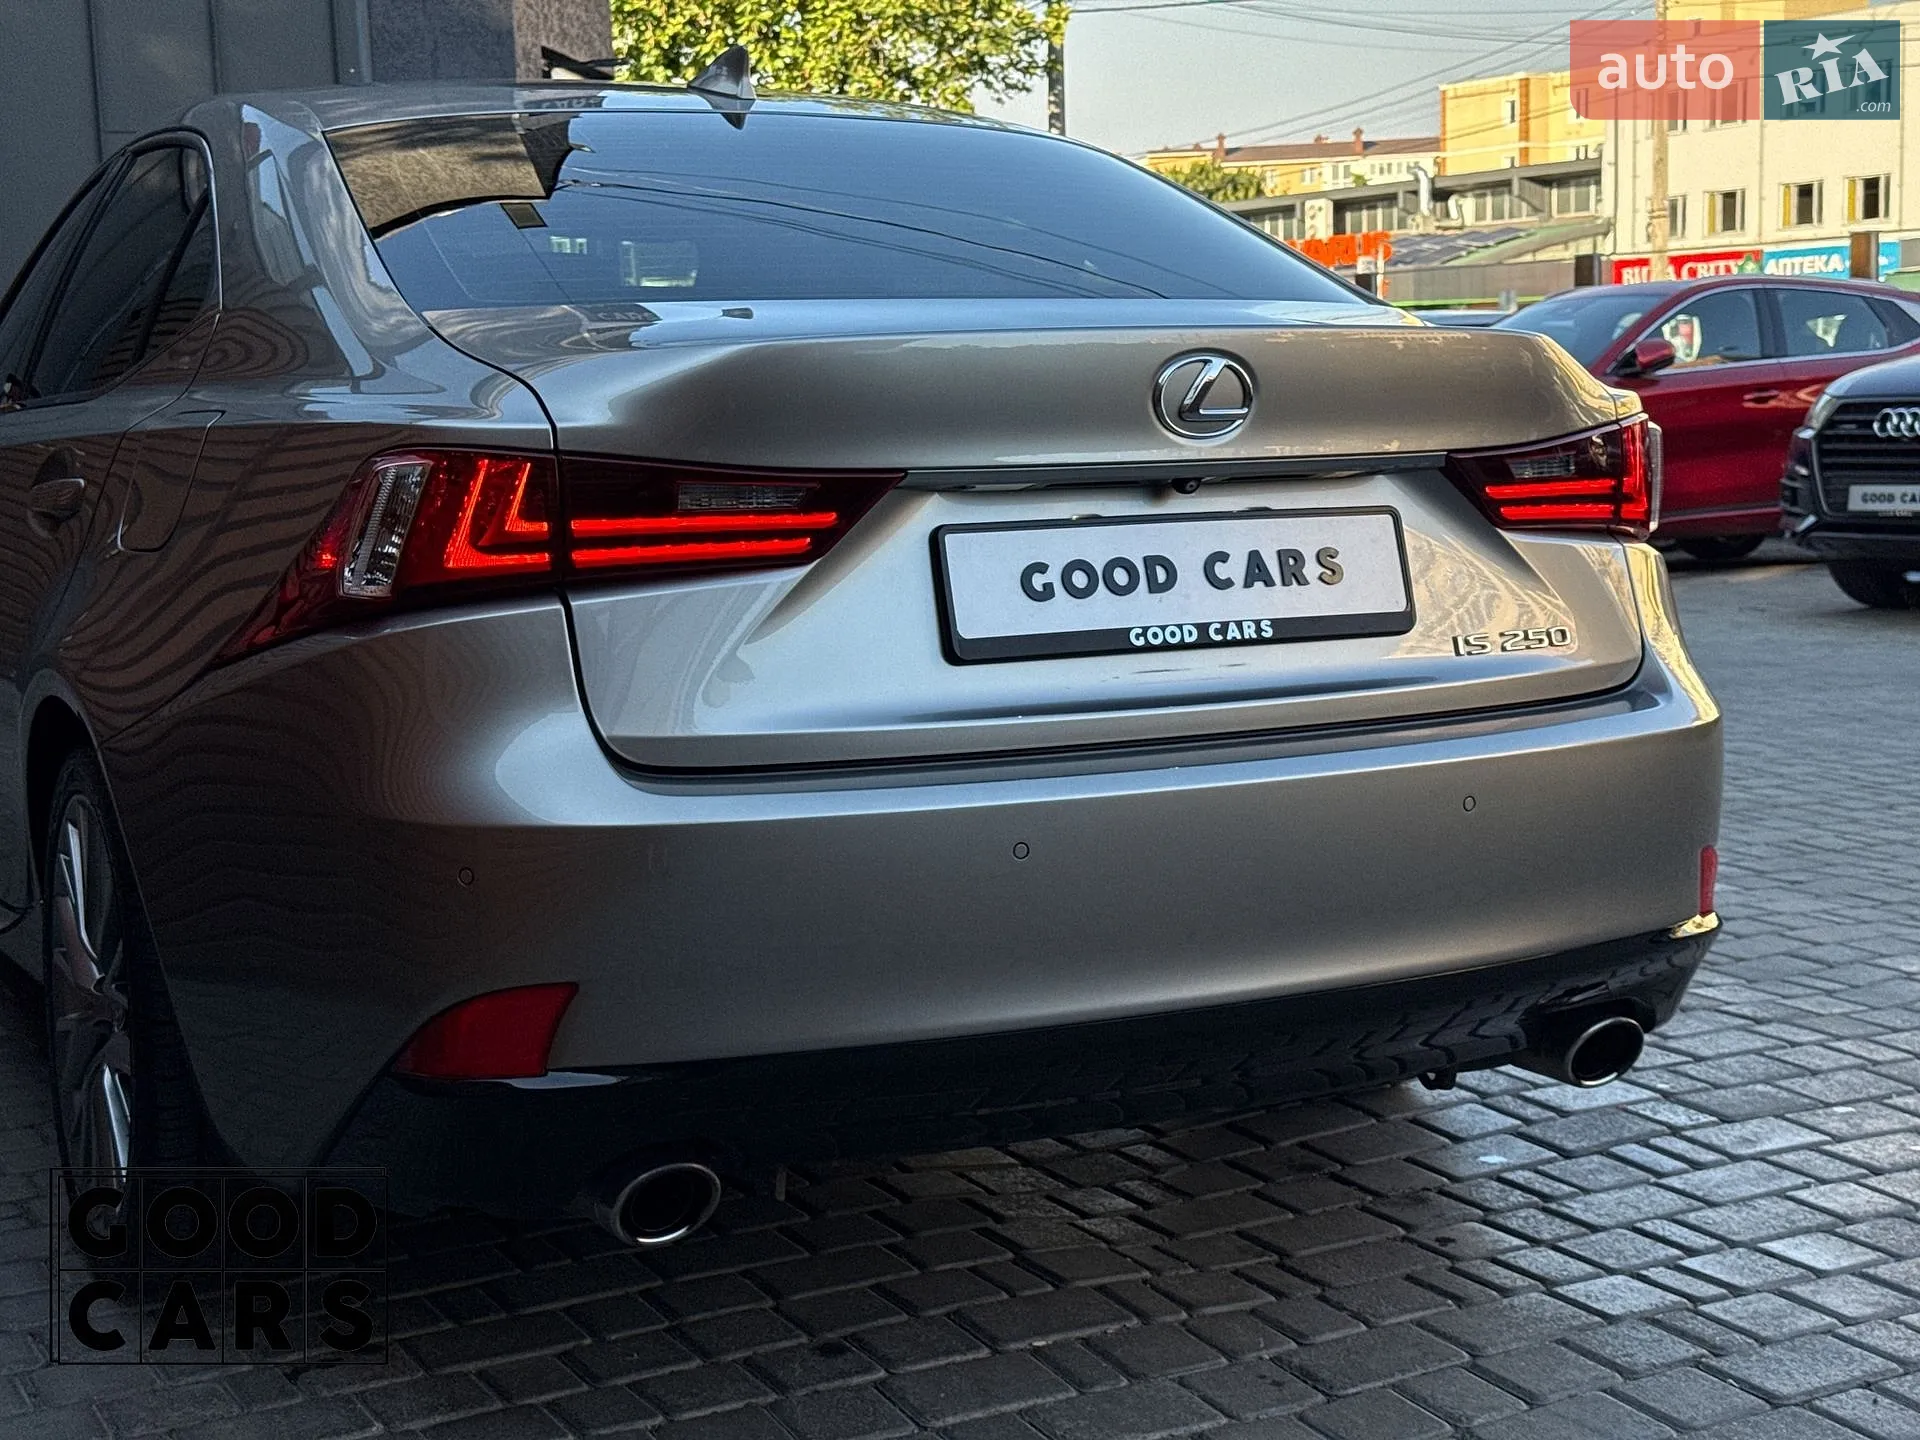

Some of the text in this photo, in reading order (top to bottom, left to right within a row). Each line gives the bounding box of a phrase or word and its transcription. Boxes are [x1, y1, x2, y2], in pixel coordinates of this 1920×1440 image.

[1764, 252, 1844, 275] АПТЕКА
[1861, 492, 1895, 504] GOOD
[1020, 546, 1344, 602] GOOD CARS
[1128, 619, 1274, 647] GOOD CARS
[1452, 625, 1572, 656] IS 250
